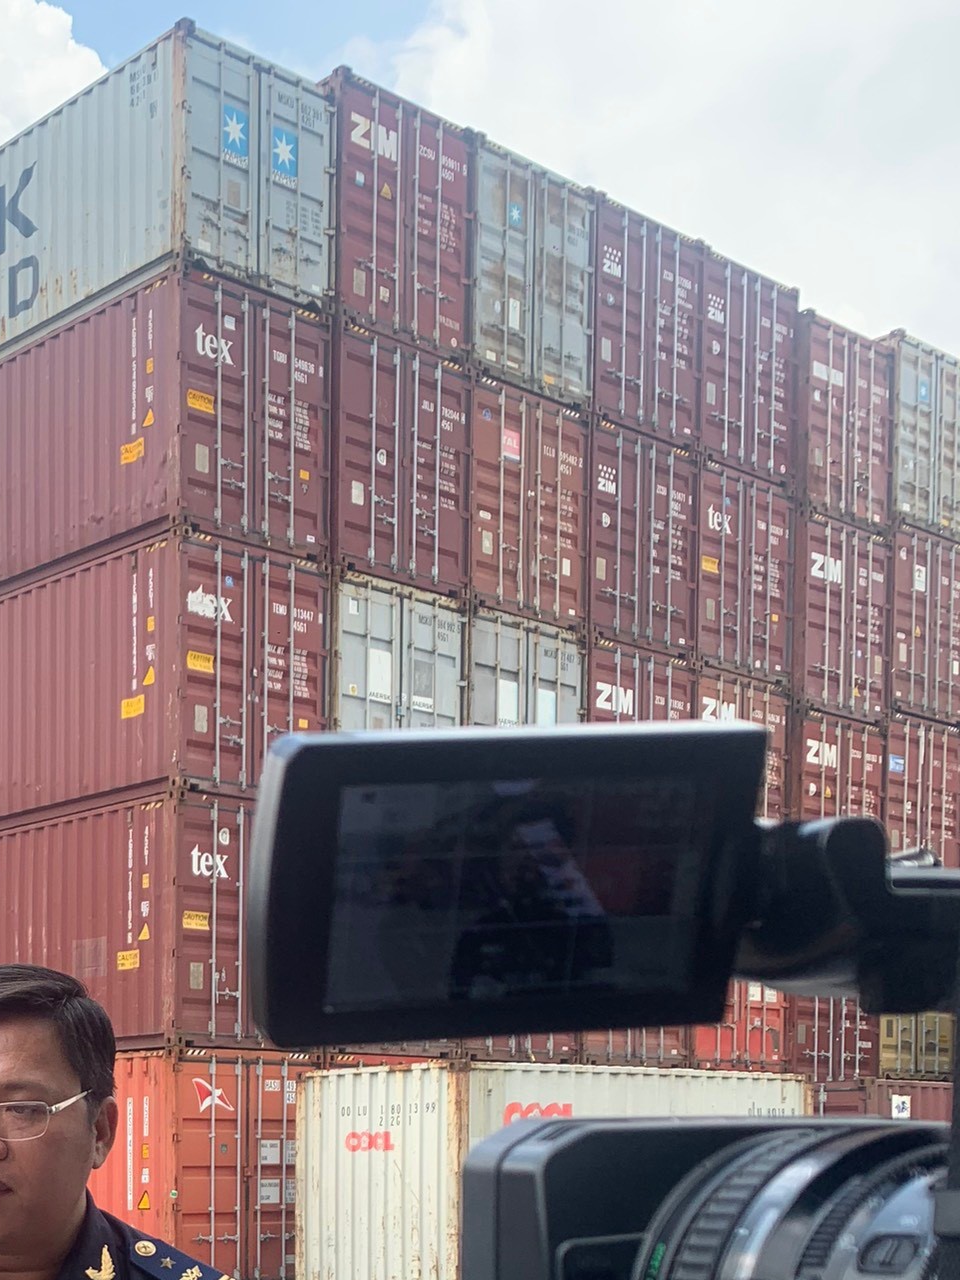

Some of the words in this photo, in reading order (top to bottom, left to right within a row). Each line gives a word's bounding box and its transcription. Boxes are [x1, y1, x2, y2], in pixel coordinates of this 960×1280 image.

[350, 111, 397, 162] ZIM
[603, 259, 622, 278] ZIM
[707, 306, 725, 324] ZIM
[195, 323, 234, 366] tex
[598, 477, 616, 495] ZIM
[707, 504, 733, 535] tex
[811, 551, 842, 584] ZIM
[272, 602, 287, 616] TEMU
[596, 681, 633, 715] ZIM
[702, 696, 737, 723] ZIM
[806, 738, 837, 768] ZIM
[190, 844, 229, 878] tex
[184, 911, 208, 923] CAUTION
